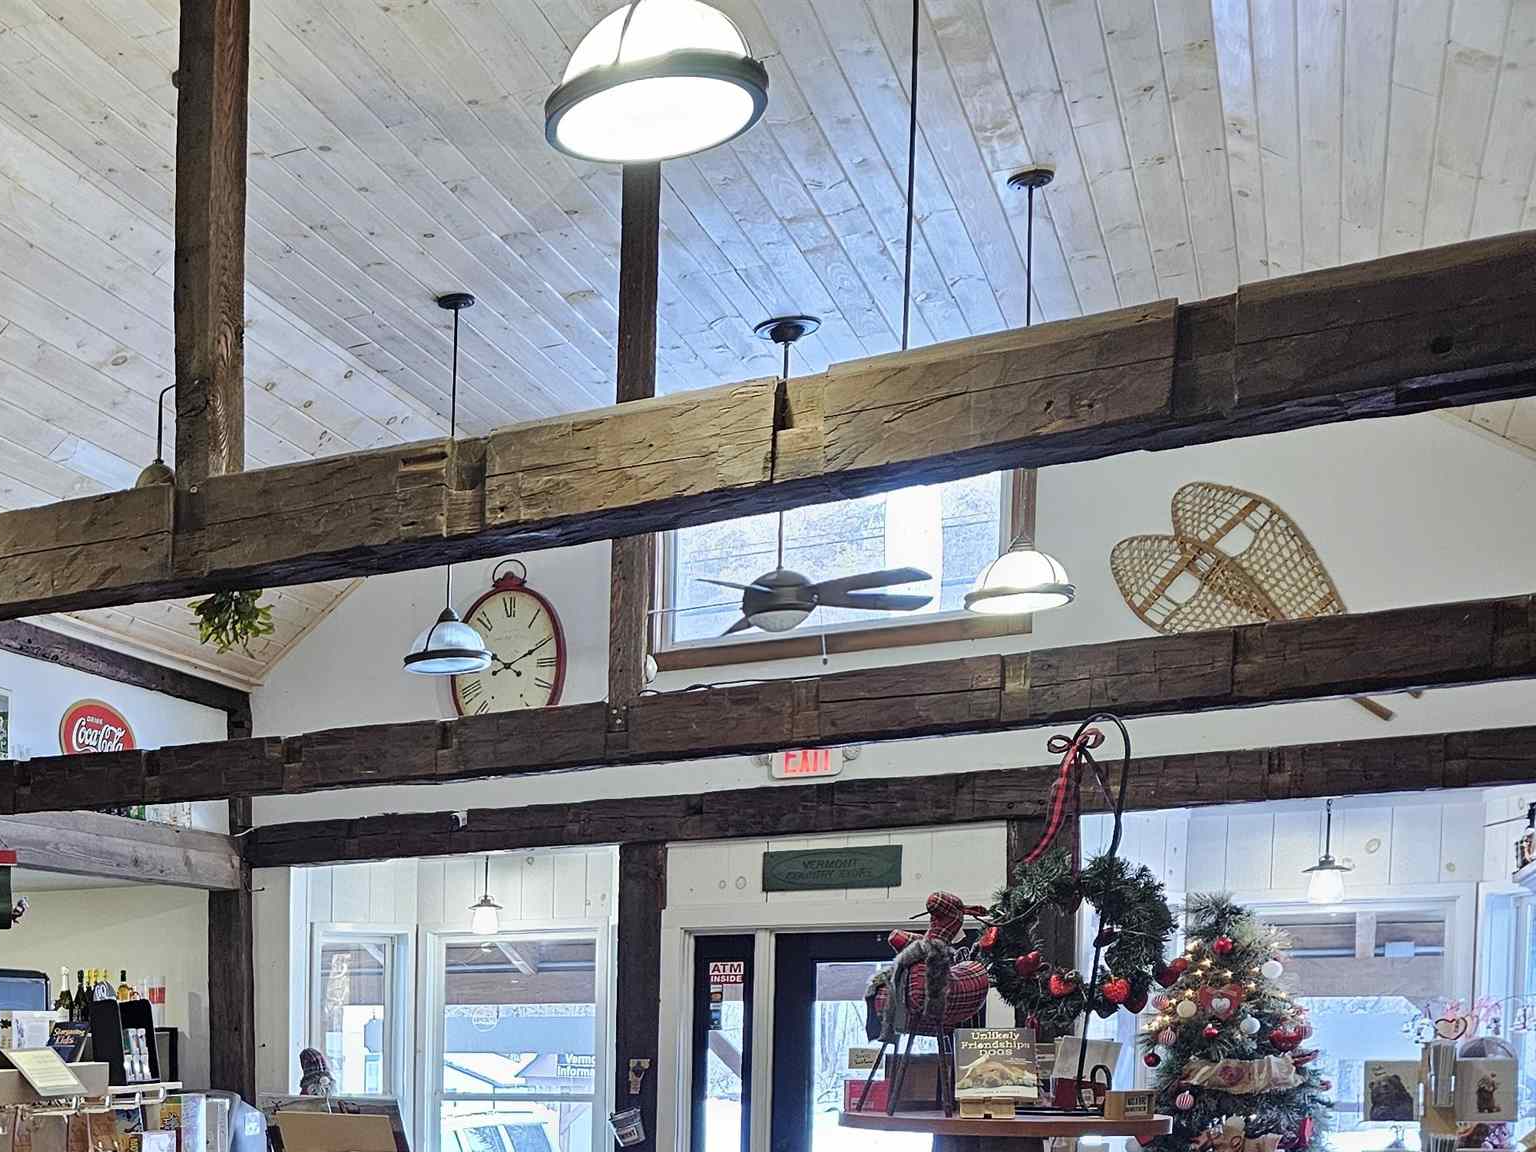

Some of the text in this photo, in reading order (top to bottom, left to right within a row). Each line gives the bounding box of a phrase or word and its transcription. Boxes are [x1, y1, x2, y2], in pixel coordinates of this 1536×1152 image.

[782, 748, 831, 774] EXIT
[711, 963, 742, 974] ATM
[710, 975, 743, 983] INSIDE
[971, 1031, 1020, 1041] Unlikely
[960, 1040, 1031, 1050] Friendships
